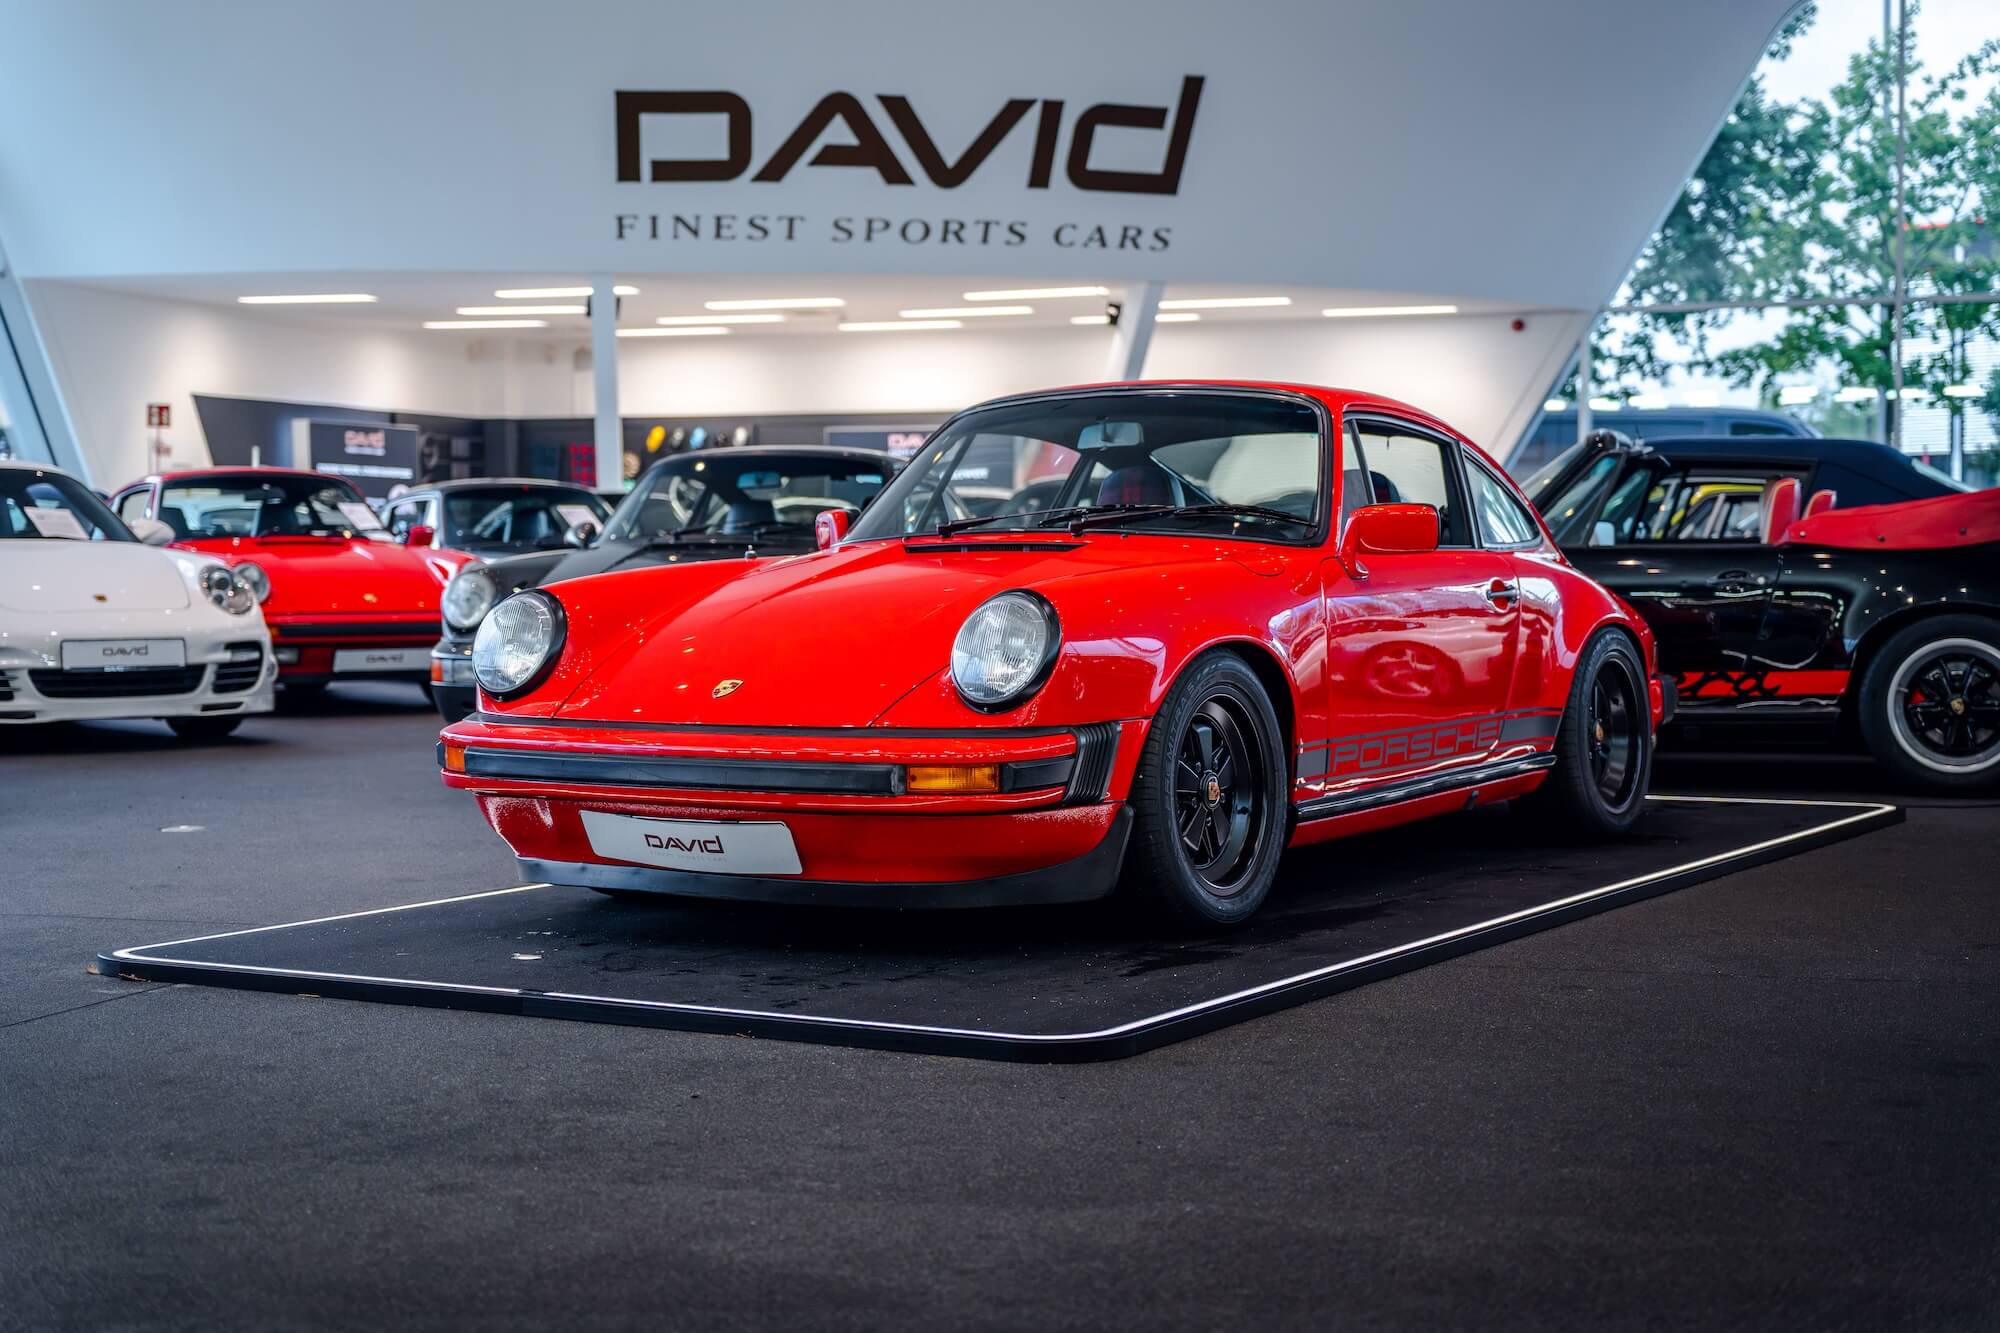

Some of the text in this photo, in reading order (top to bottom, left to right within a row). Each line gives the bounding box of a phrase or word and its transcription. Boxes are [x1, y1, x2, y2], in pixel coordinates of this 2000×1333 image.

[615, 214, 1174, 252] FINEST SPORTS CARS
[1333, 720, 1499, 774] PORSCHE
